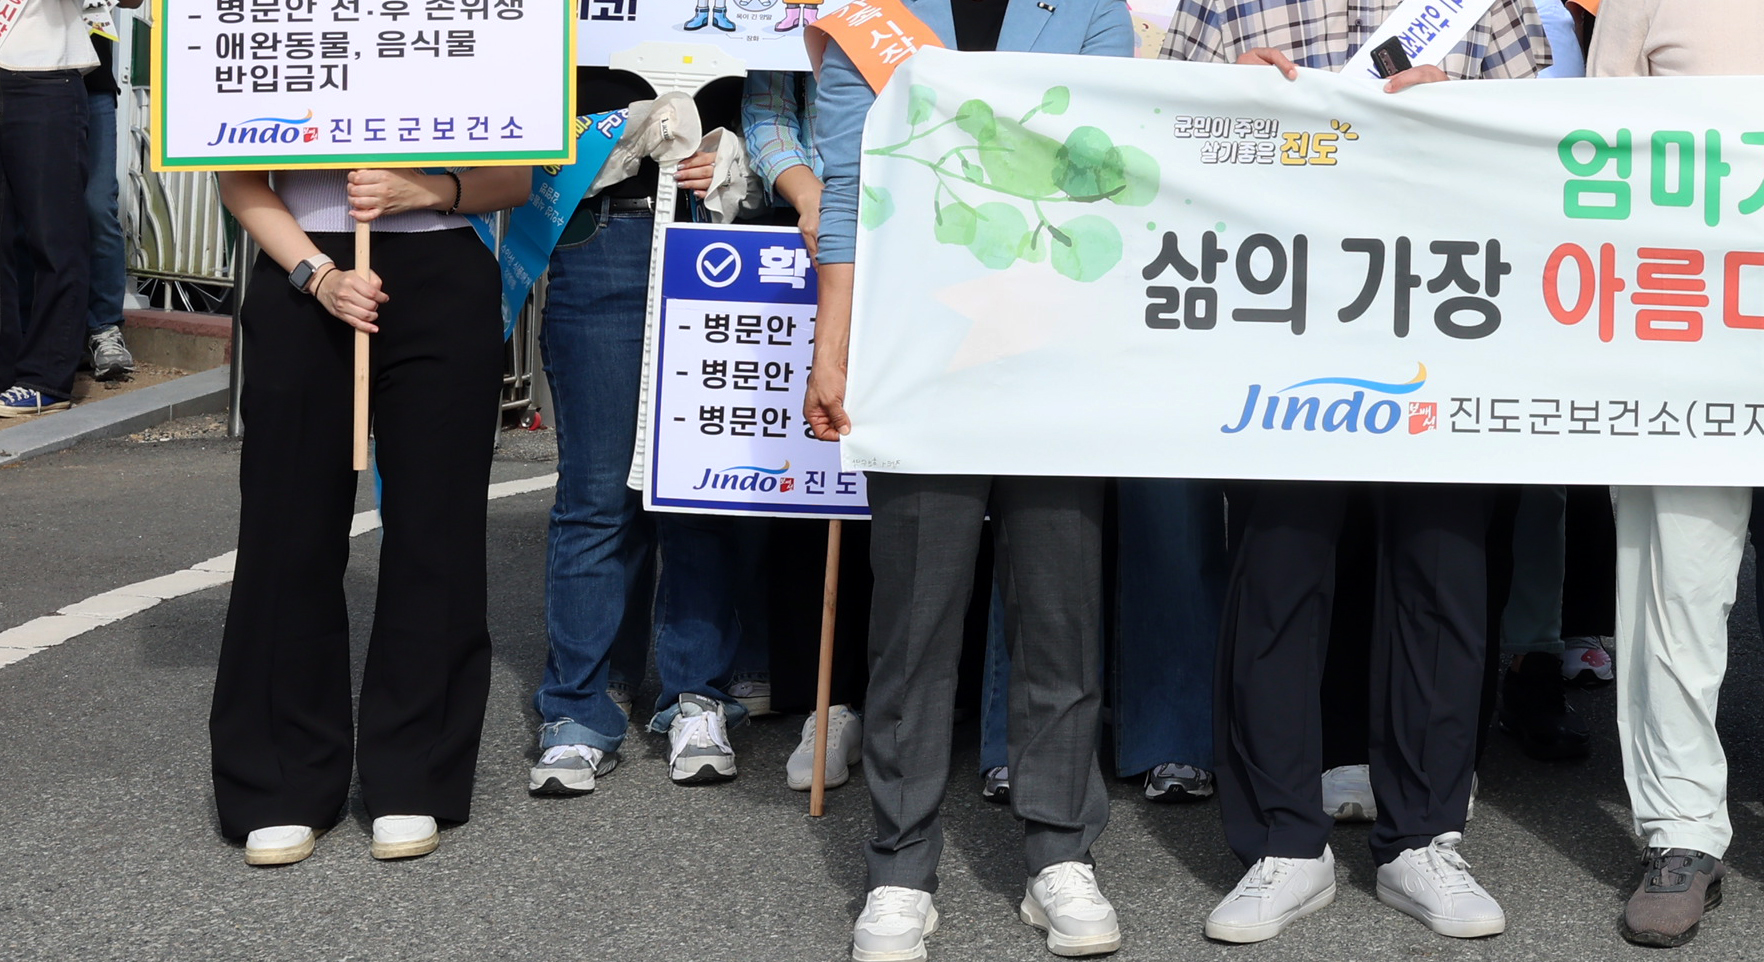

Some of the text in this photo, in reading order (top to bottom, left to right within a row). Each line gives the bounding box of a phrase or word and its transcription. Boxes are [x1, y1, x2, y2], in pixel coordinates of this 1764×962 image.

[215, 29, 476, 61] 애완동물, 음식물
[215, 63, 349, 94] 반입금지
[207, 114, 524, 146] Jindo 진도군보건소
[1174, 114, 1280, 139] 군민이 주인!
[1200, 131, 1340, 167] 살기좋은 진도
[1142, 230, 1309, 336] 삶의
[1338, 235, 1512, 340] 가장
[704, 313, 797, 346] 병문안
[701, 358, 794, 392] 병문안
[698, 404, 791, 438] 병문안
[1220, 383, 1402, 435] Jindo
[693, 468, 777, 492] Jindo
